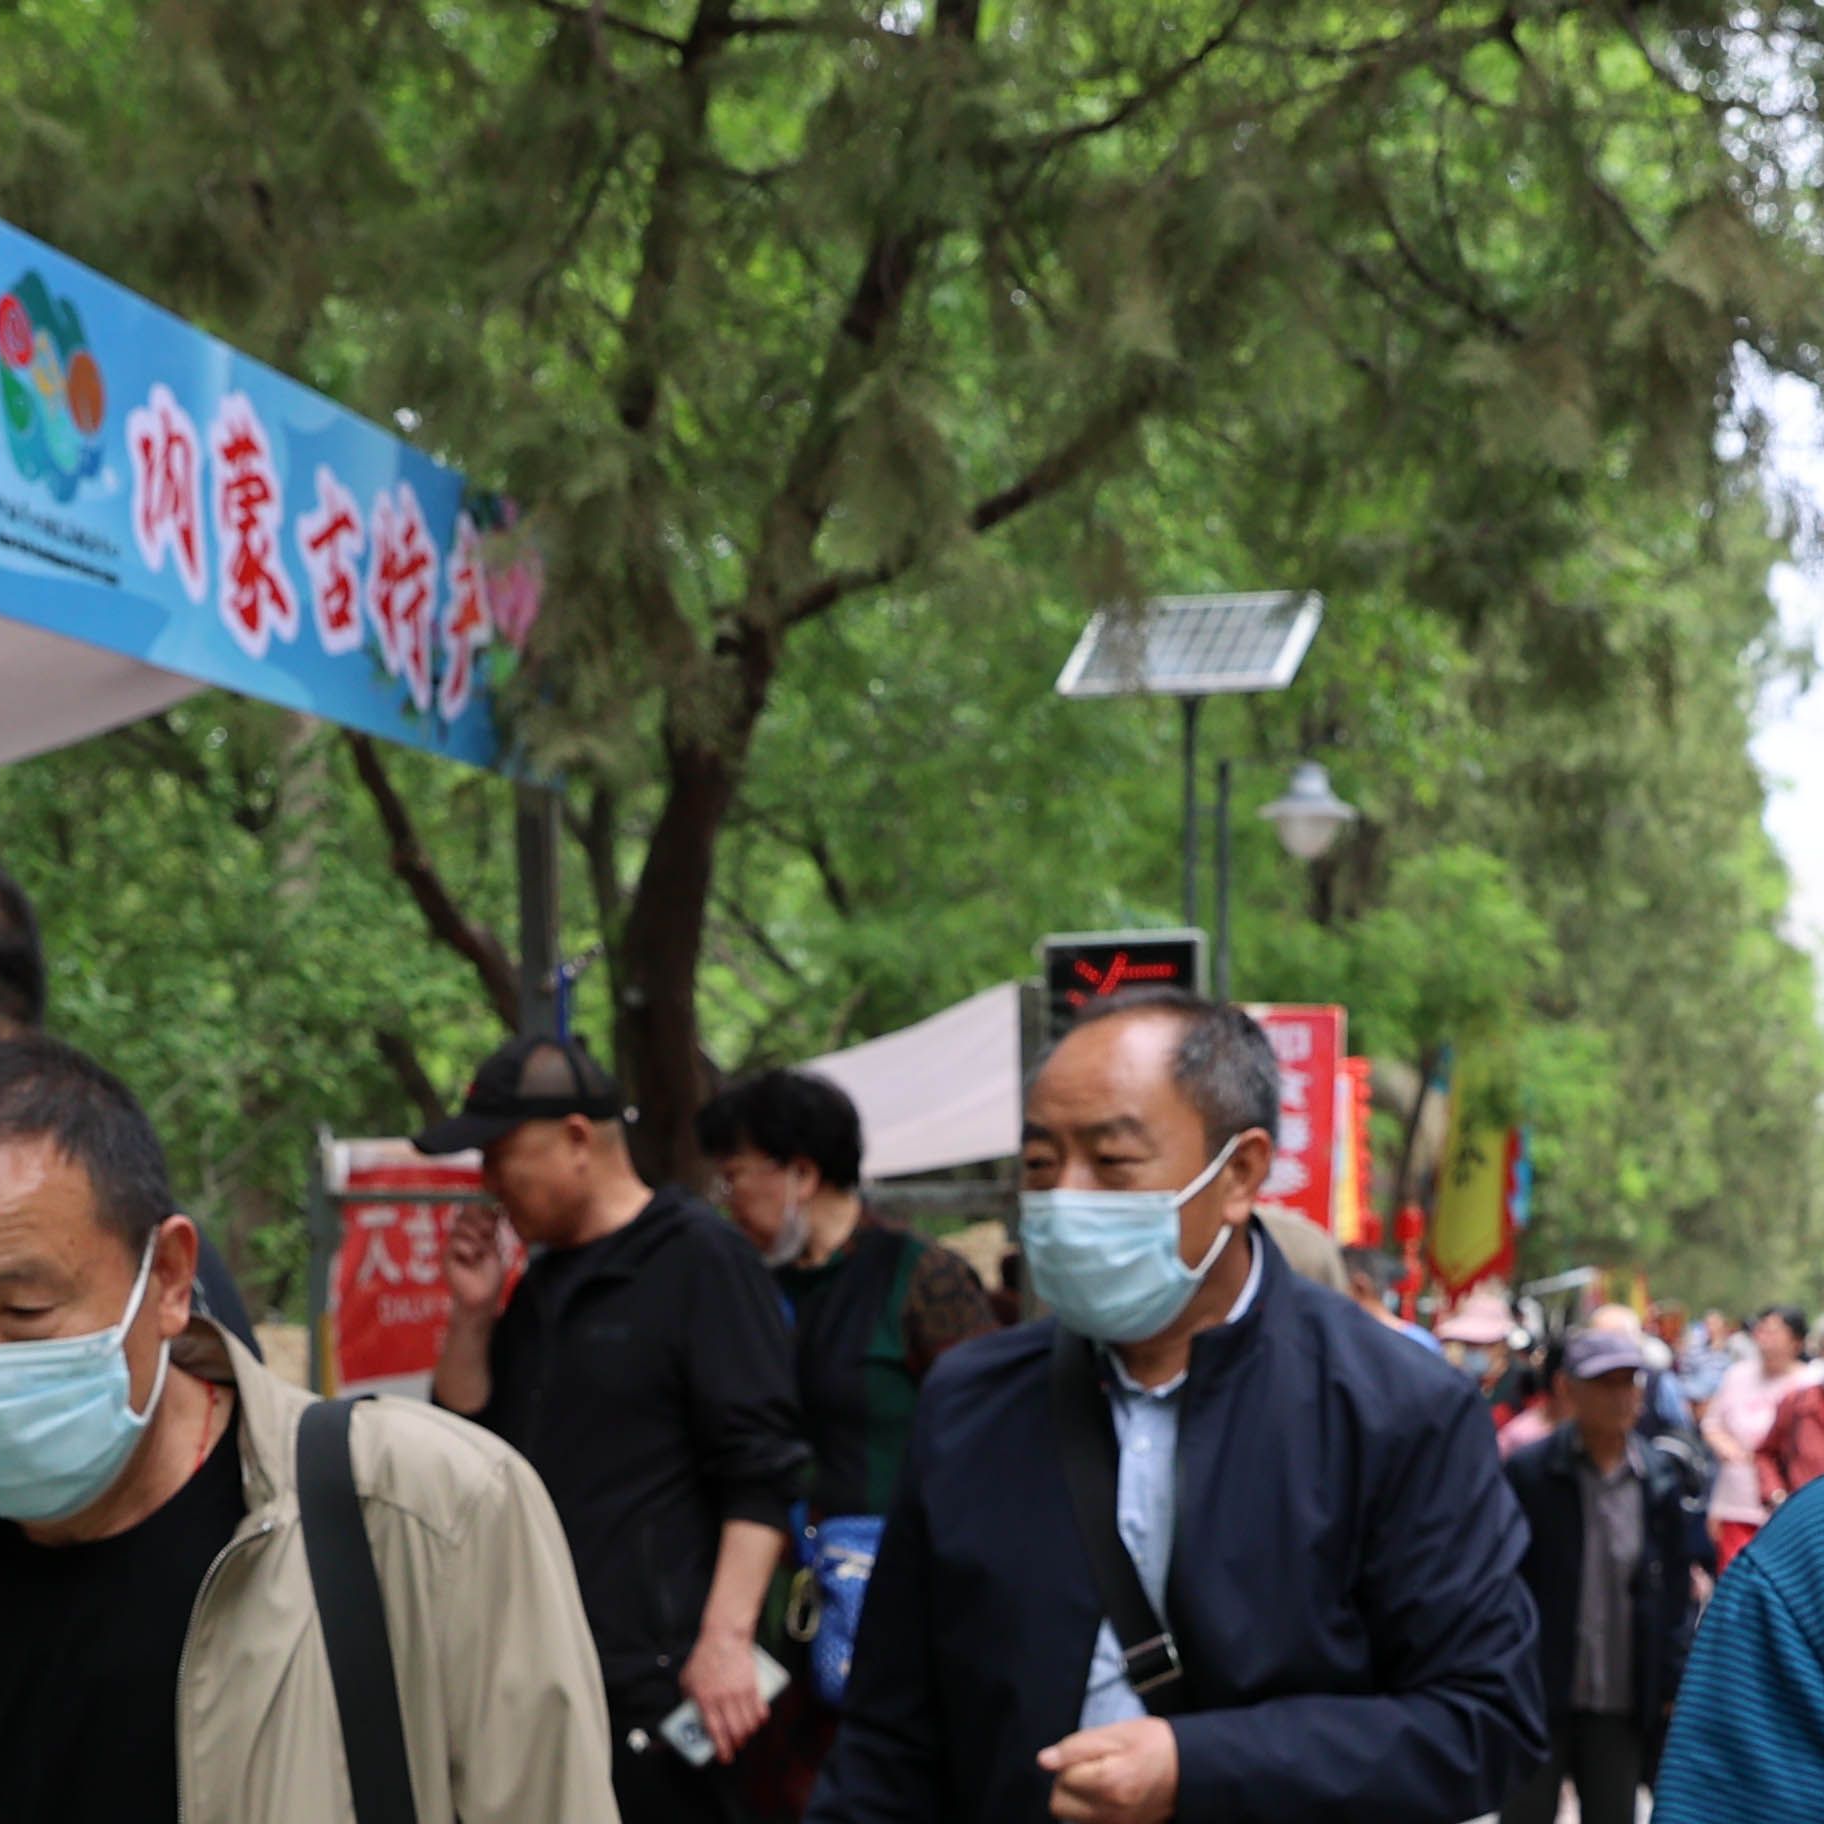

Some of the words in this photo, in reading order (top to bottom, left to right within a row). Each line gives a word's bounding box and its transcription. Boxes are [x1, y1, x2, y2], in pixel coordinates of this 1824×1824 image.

[138, 405, 484, 702] 内蒙古特产
